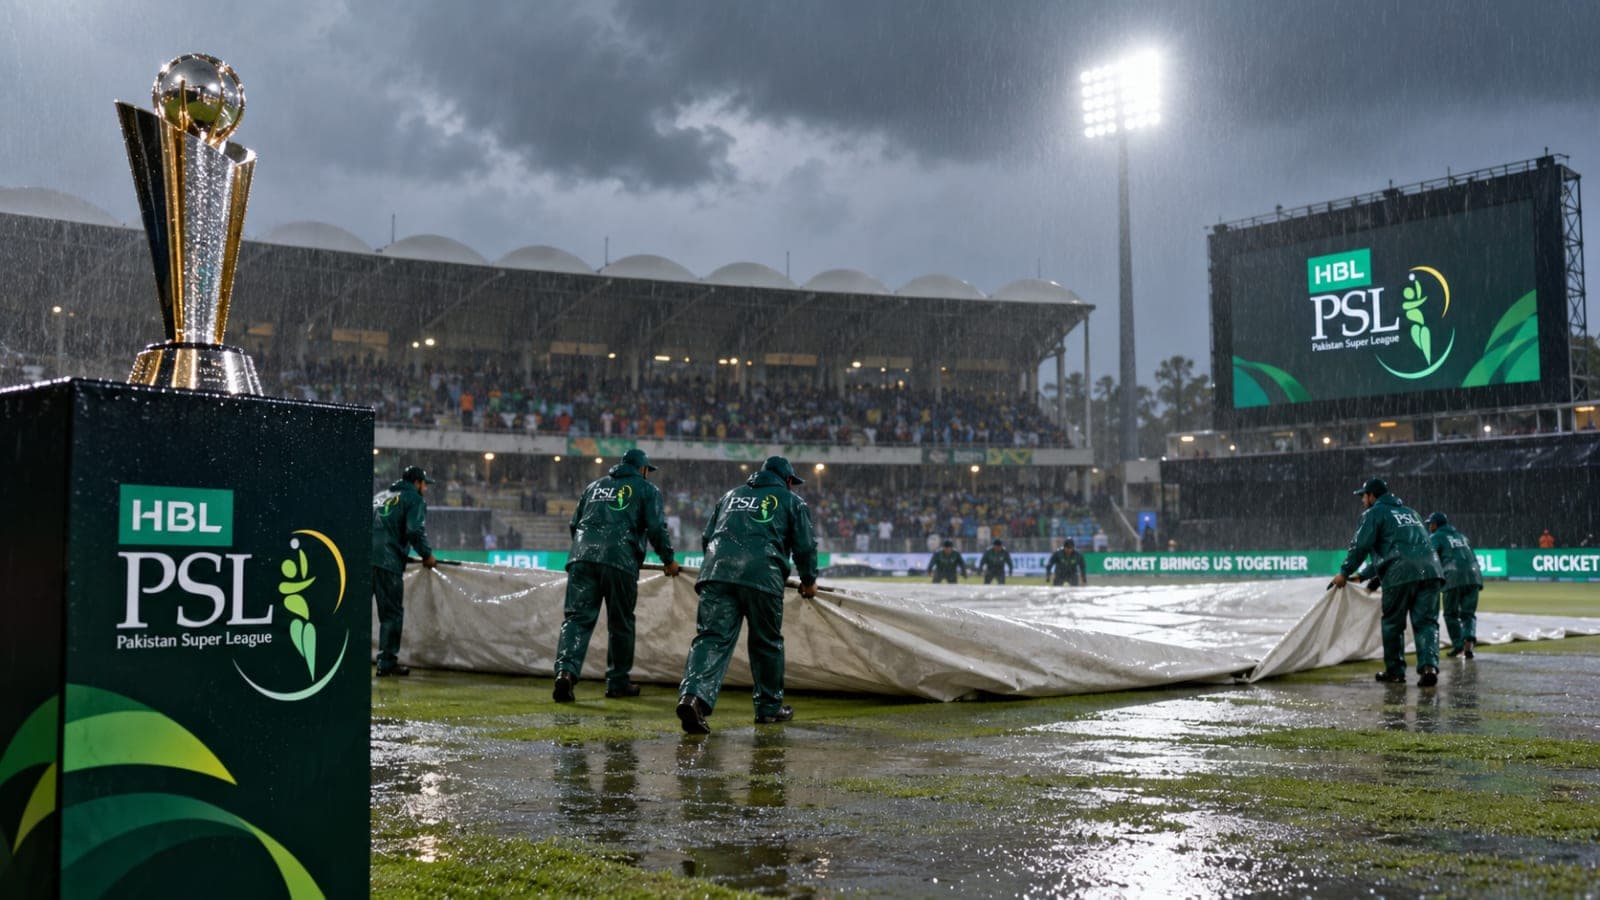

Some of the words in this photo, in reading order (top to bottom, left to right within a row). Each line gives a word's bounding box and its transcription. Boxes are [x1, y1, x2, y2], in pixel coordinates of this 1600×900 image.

[1315, 260, 1364, 284] HBL
[1310, 287, 1400, 340] PSL
[1312, 340, 1344, 351] Pakistan
[1345, 338, 1369, 349] Super
[1370, 335, 1400, 346] League
[591, 487, 617, 500] PSL
[728, 496, 760, 510] PSL
[132, 499, 222, 533] HBL
[1103, 556, 1157, 571] CRICKET
[1160, 556, 1209, 571] BRINGS
[1213, 556, 1232, 571] US
[1237, 556, 1308, 571] TOGETHER
[1475, 554, 1502, 572] BL
[1532, 555, 1600, 572] CRICKET
[116, 552, 274, 629] PSL
[117, 633, 177, 649] Pakistan
[182, 632, 222, 649] Super
[226, 631, 272, 647] League
